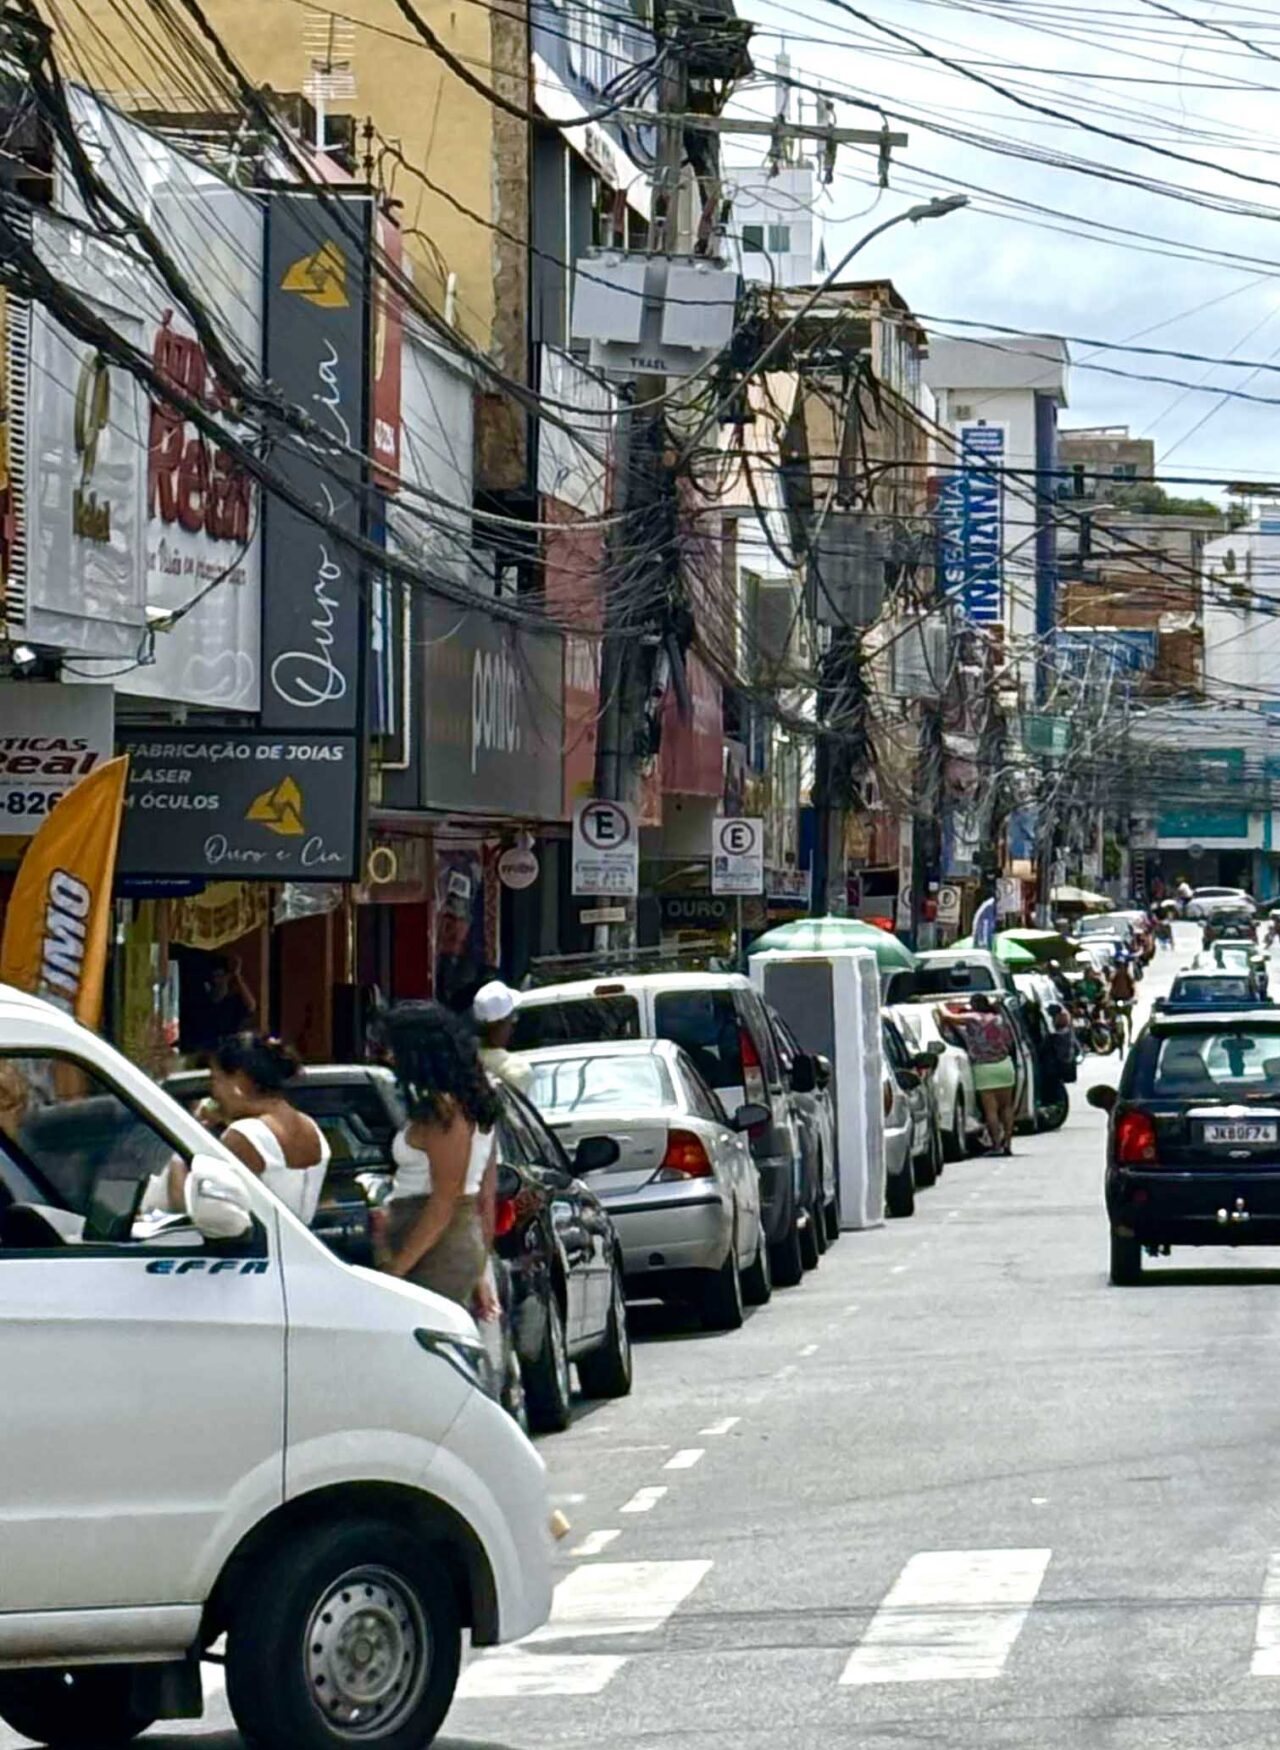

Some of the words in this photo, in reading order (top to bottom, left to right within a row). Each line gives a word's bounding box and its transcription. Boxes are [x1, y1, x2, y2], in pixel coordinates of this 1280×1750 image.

[271, 544, 347, 706] Ouro
[0, 738, 89, 752] TICAS
[126, 742, 250, 763] FABRICAÇÃO
[255, 745, 283, 760] DE
[285, 745, 344, 761] JOIAS
[0, 752, 99, 774] eal
[130, 768, 192, 784] LASER
[140, 792, 220, 810] ÓCULOS
[596, 811, 614, 839] E
[731, 828, 744, 848] E
[667, 901, 726, 918] OURO
[41, 868, 91, 996] IMO
